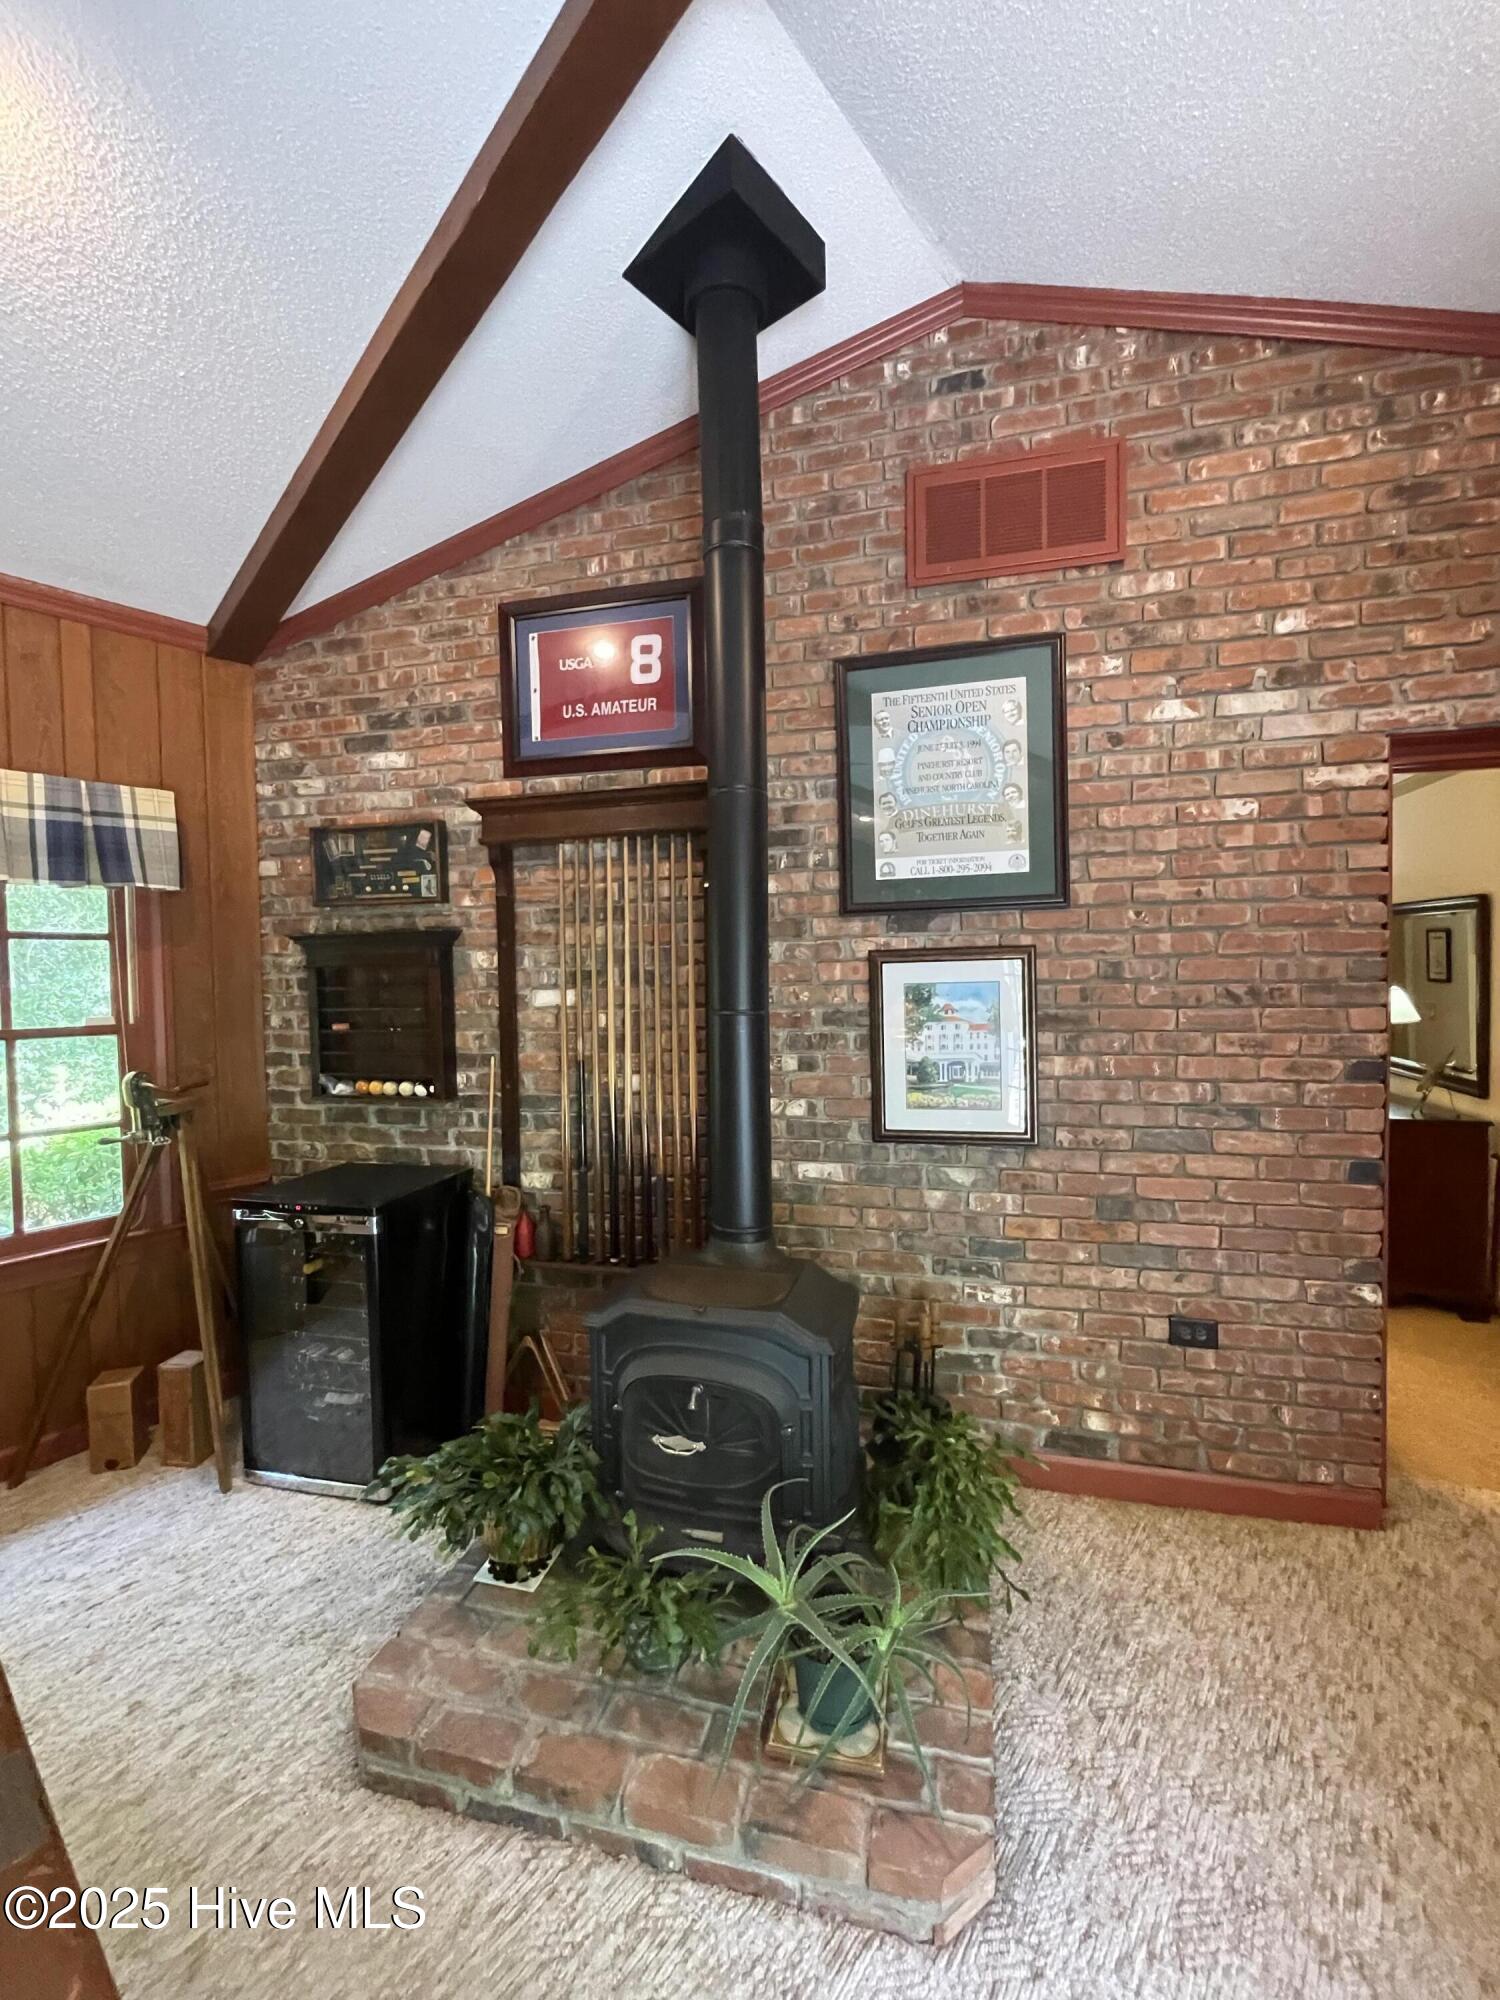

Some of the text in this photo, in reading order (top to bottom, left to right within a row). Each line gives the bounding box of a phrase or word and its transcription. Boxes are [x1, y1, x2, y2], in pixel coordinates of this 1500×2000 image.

[559, 656, 593, 671] USGA
[630, 633, 662, 685] 8
[883, 684, 1016, 708] THE FIFTEENTH UNITED STATES
[562, 697, 657, 719] U.S. AMATEUR
[911, 699, 987, 719] SENIOR OPEN
[907, 714, 991, 734] CHAMPIONSHIP
[924, 815, 965, 828] GREATEST
[916, 828, 985, 843] TOGETHER AGAIN
